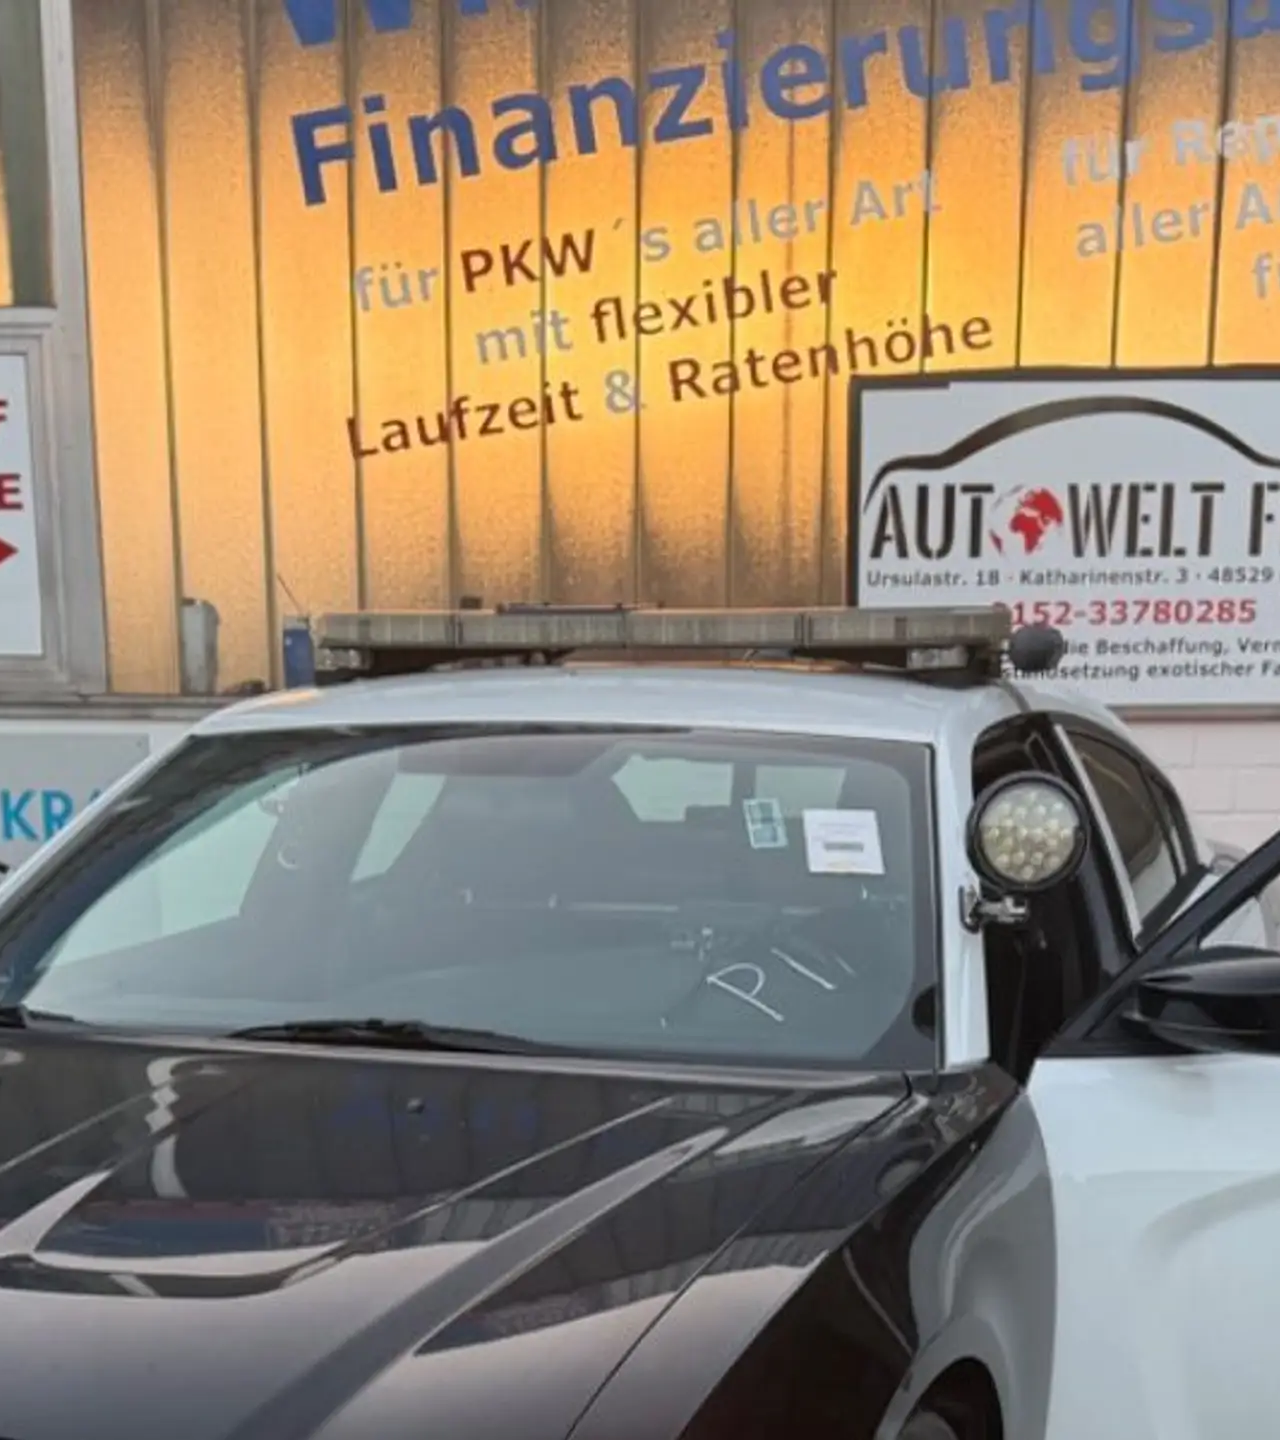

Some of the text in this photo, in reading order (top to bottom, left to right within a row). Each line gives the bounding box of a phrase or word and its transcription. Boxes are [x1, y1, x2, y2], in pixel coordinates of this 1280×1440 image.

[354, 259, 439, 311] für
[694, 197, 827, 256] aller
[850, 173, 943, 226] Art
[1076, 198, 1209, 258] aller
[476, 267, 838, 365] mit flexibler
[347, 313, 994, 460] Laufzeit & Ratenhöhe
[867, 569, 967, 587] Ursulastr.
[1020, 568, 1168, 586] Katharinenstr.
[1176, 567, 1189, 584] 3
[1207, 566, 1274, 584] 48529
[993, 599, 1257, 627] 152-33780285
[1147, 660, 1254, 679] exotischer
